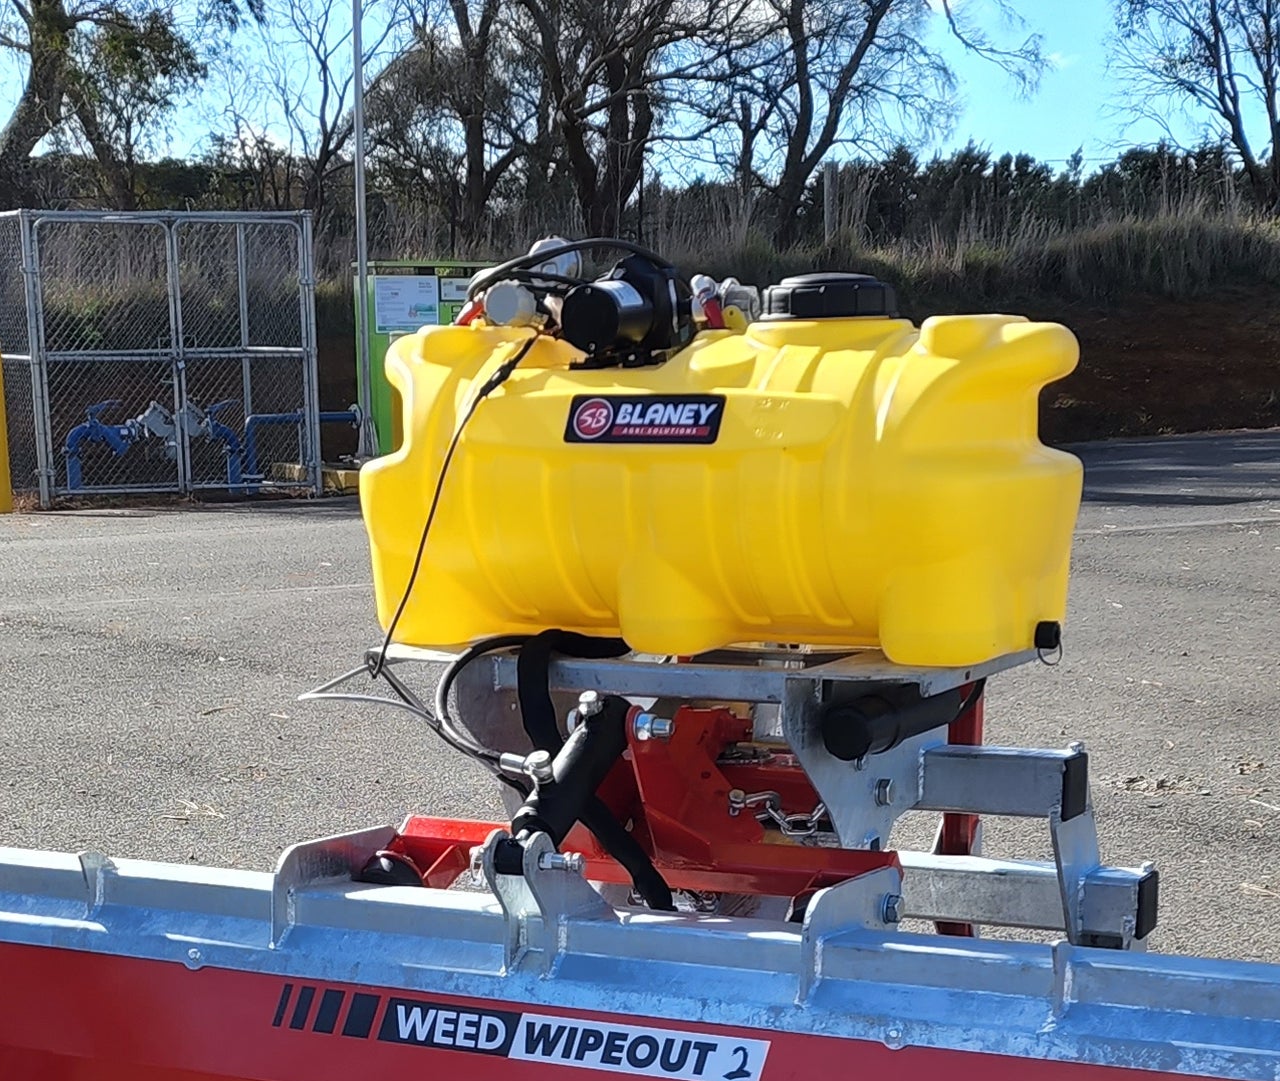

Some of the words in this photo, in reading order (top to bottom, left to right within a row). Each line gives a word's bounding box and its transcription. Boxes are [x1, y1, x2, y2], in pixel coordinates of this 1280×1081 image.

[615, 403, 718, 425] BLANEY
[621, 427, 645, 435] AGRI
[647, 427, 698, 436] SOLUTIONS
[396, 1005, 507, 1051] WEED
[524, 1021, 718, 1077] WIPEOUT
[721, 1046, 753, 1081] 2
